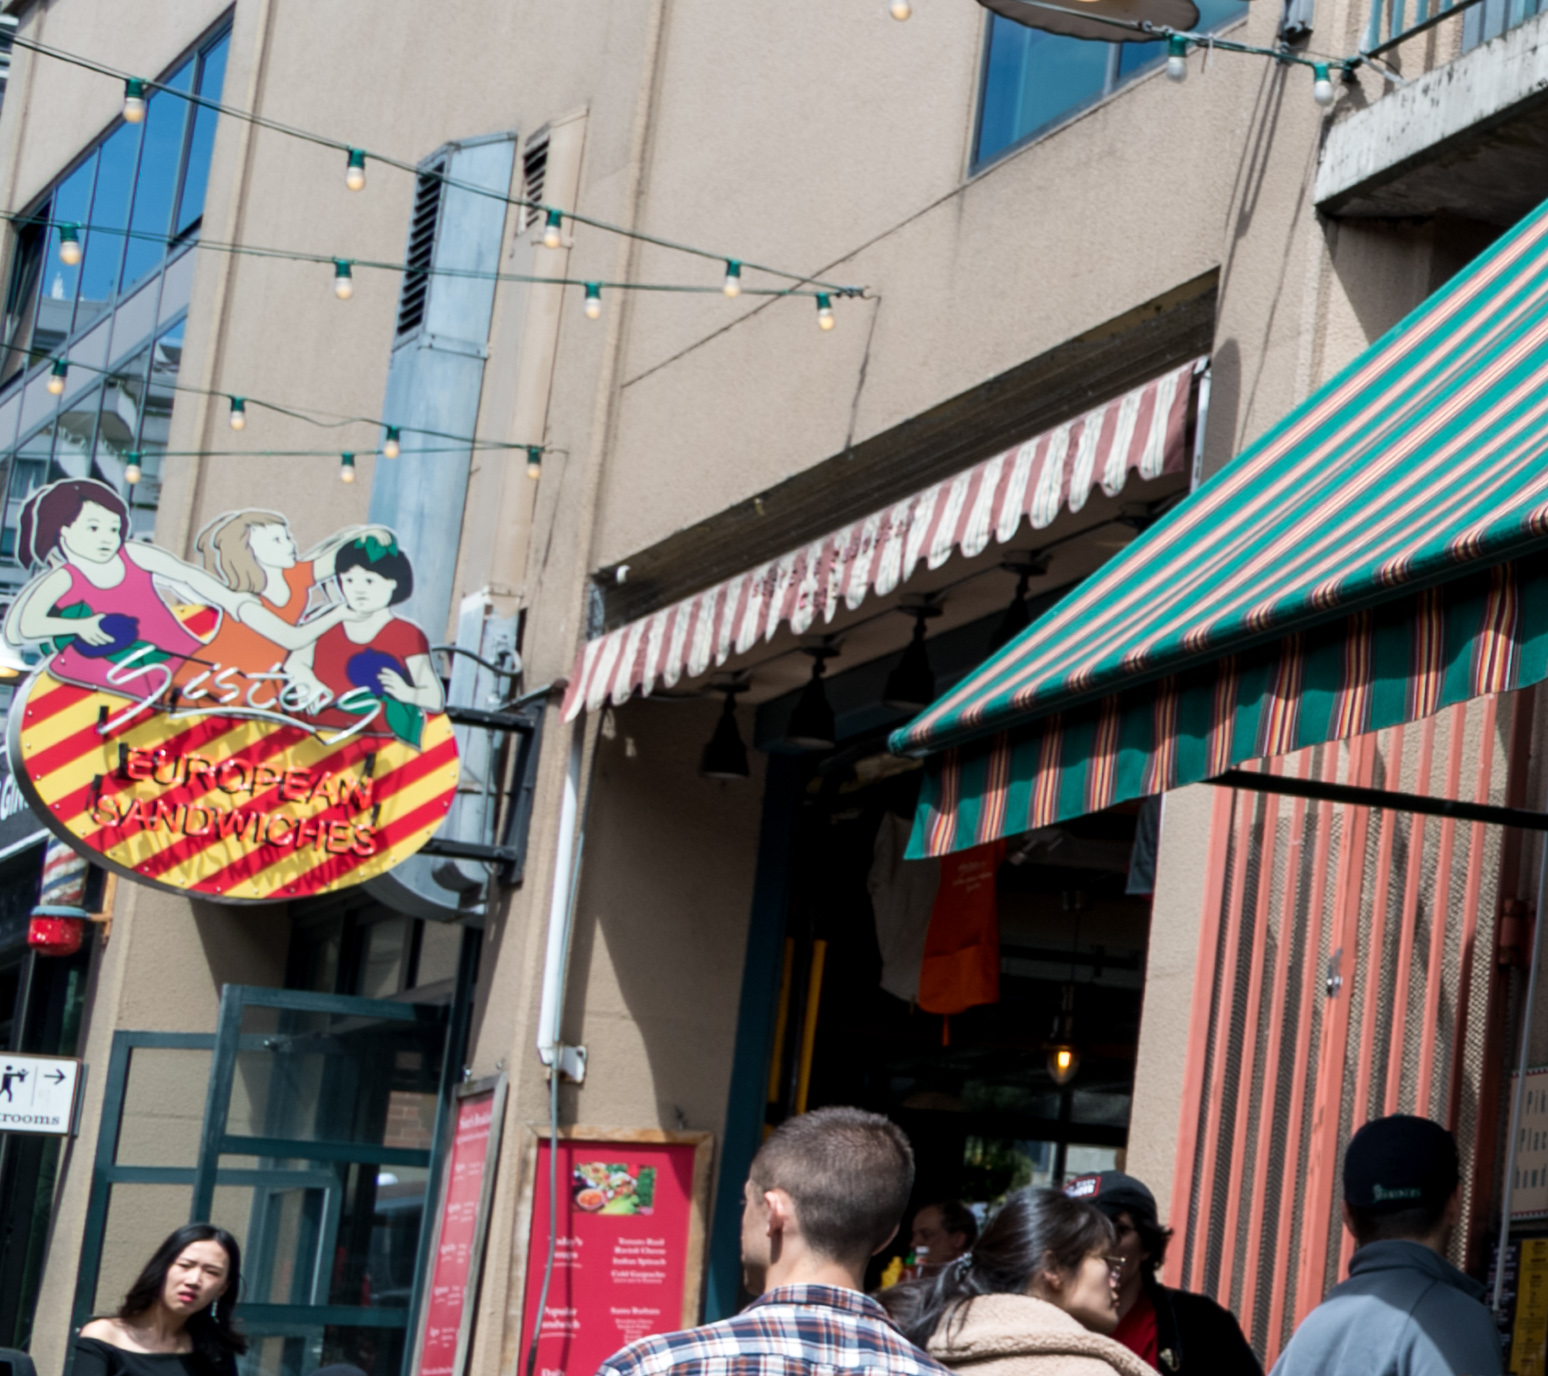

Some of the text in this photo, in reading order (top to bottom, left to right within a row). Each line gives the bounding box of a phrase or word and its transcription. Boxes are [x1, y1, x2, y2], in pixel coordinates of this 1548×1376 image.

[97, 644, 384, 746] Sisters
[126, 746, 374, 811] EUROPEAN
[91, 794, 378, 857] SANDWICHES
